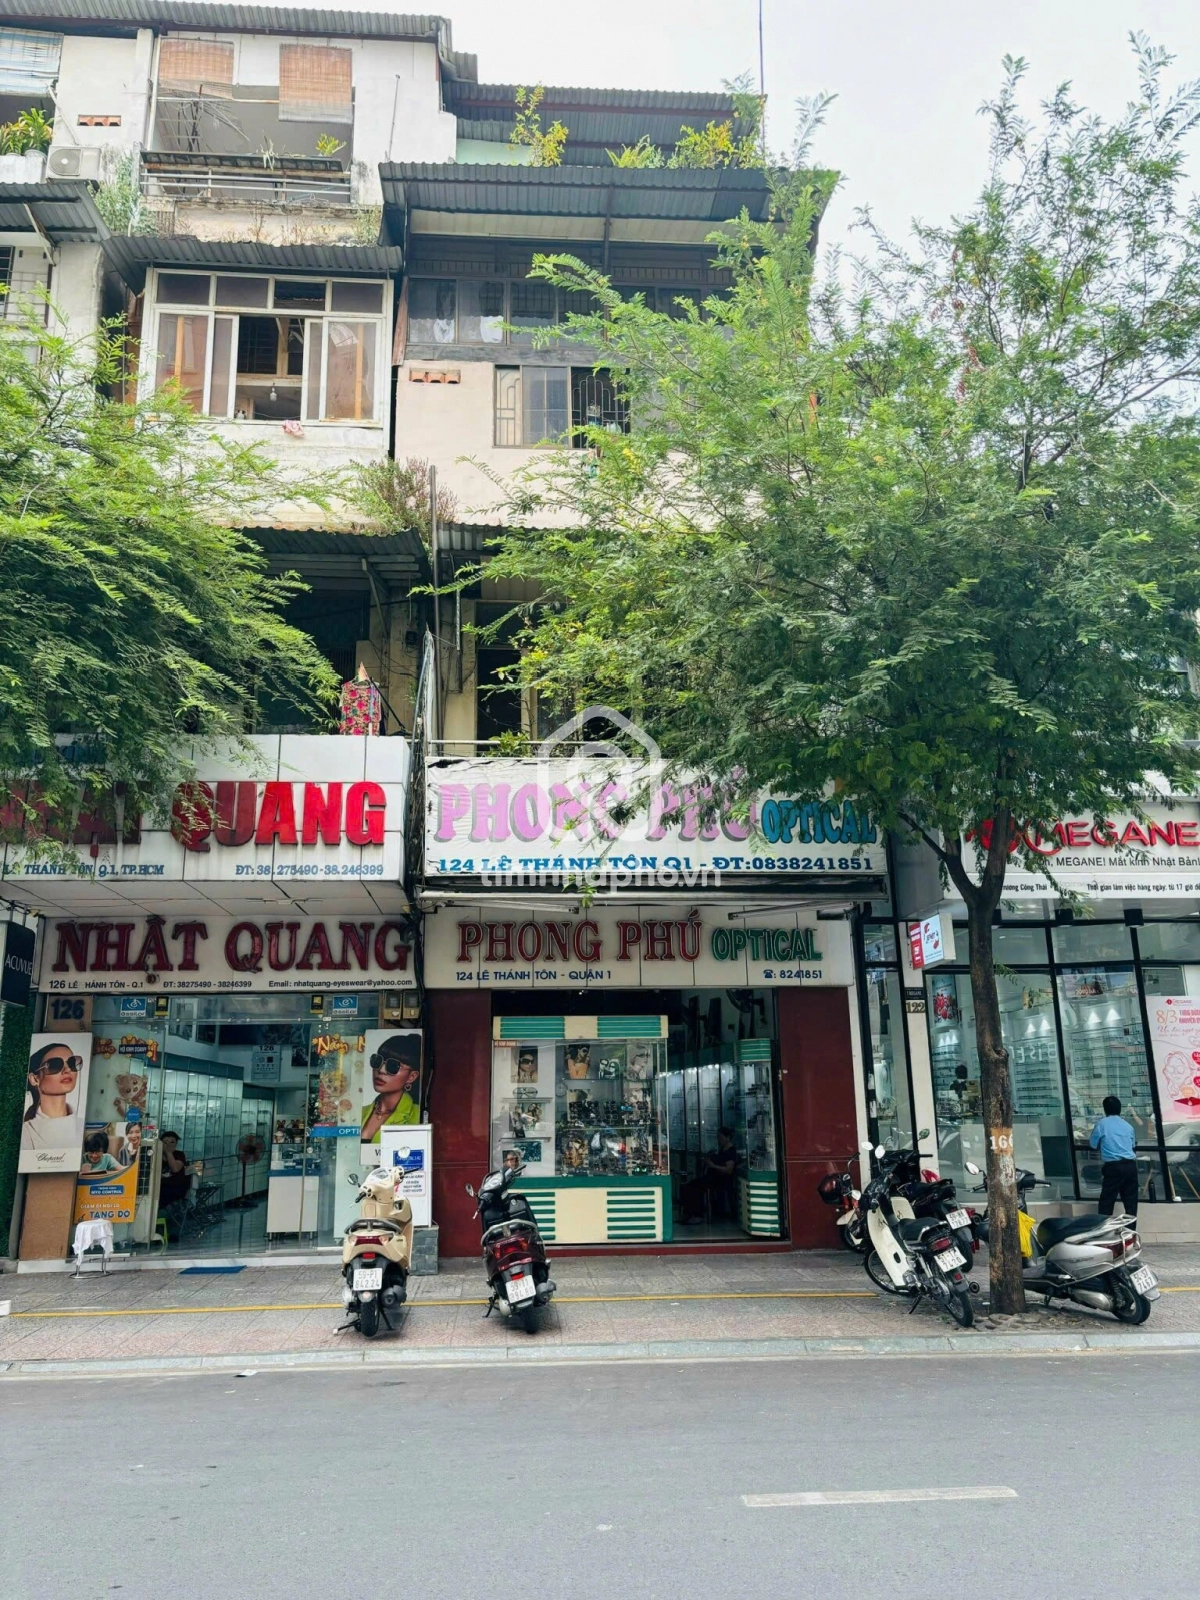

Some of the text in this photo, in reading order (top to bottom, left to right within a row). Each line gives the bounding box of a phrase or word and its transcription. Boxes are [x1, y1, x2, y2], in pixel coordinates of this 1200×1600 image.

[761, 798, 877, 844] OPTICAL
[121, 865, 164, 875] TP.HCM
[440, 858, 475, 871] 124
[481, 855, 512, 871] LÊ
[519, 854, 602, 871] THÁNH
[609, 854, 657, 870] TÔN
[664, 857, 692, 870] Q1
[1056, 857, 1106, 866] MEGANE!
[1152, 857, 1176, 868] Nhật
[456, 908, 823, 962] PHONG PHÚ OPTICAL
[52, 914, 412, 986] NHẬT QUANG
[5, 954, 33, 976] ACUVUE
[456, 971, 473, 980] 124
[477, 969, 490, 980] LÊ
[494, 968, 532, 980] THÁNH
[534, 968, 557, 980] TÔN
[569, 969, 604, 982] QUẬN
[607, 970, 612, 979] 1
[49, 980, 66, 989] 126
[68, 979, 78, 988] LÊ
[109, 979, 126, 988] TÔN
[294, 980, 412, 989] nhatquang-eyeswear@yahoo.com
[51, 1000, 85, 1019] 126
[906, 1002, 925, 1012] 122
